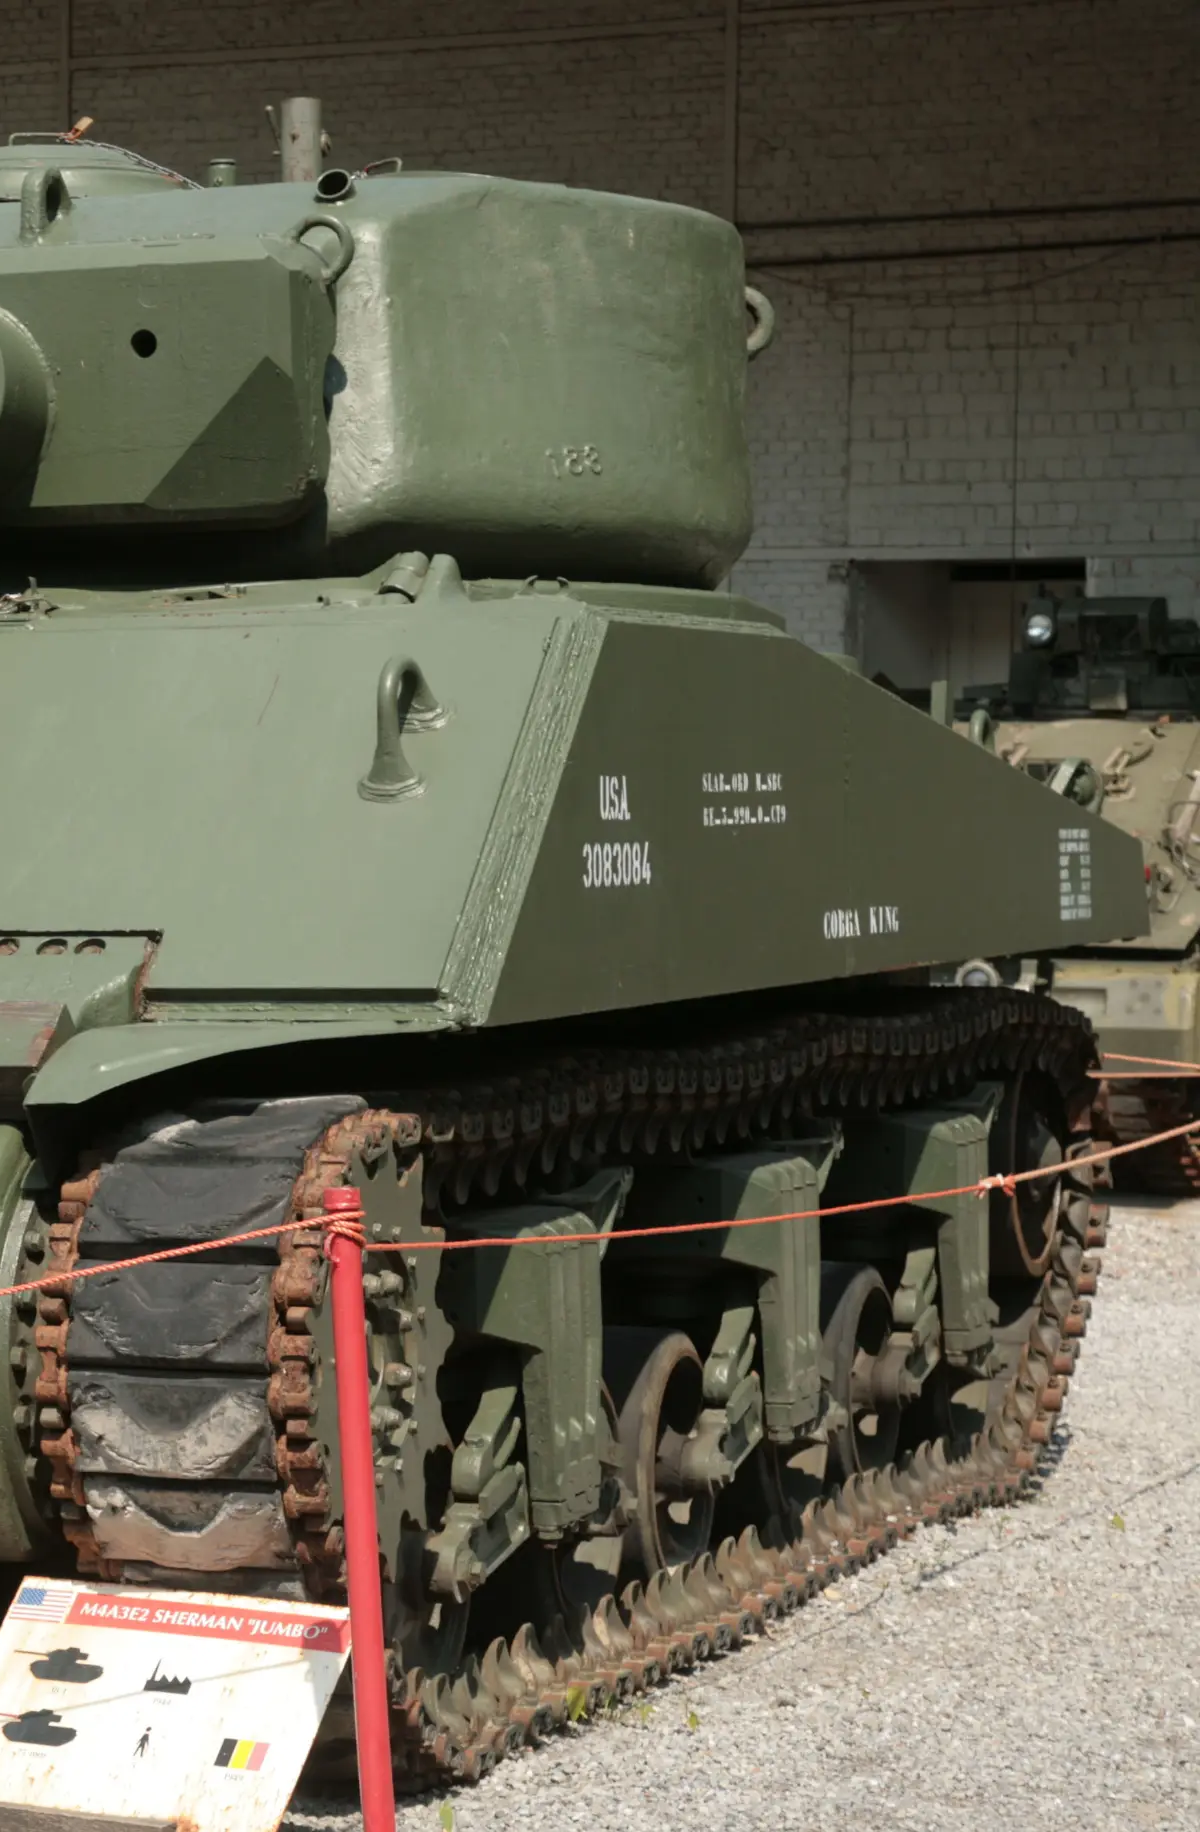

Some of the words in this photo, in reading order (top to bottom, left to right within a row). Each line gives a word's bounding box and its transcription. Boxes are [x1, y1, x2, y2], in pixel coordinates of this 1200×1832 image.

[582, 841, 651, 888] 3083084
[869, 905, 900, 935] KING
[80, 1601, 151, 1623] M4A3E2
[152, 1608, 245, 1632] SHERMAN
